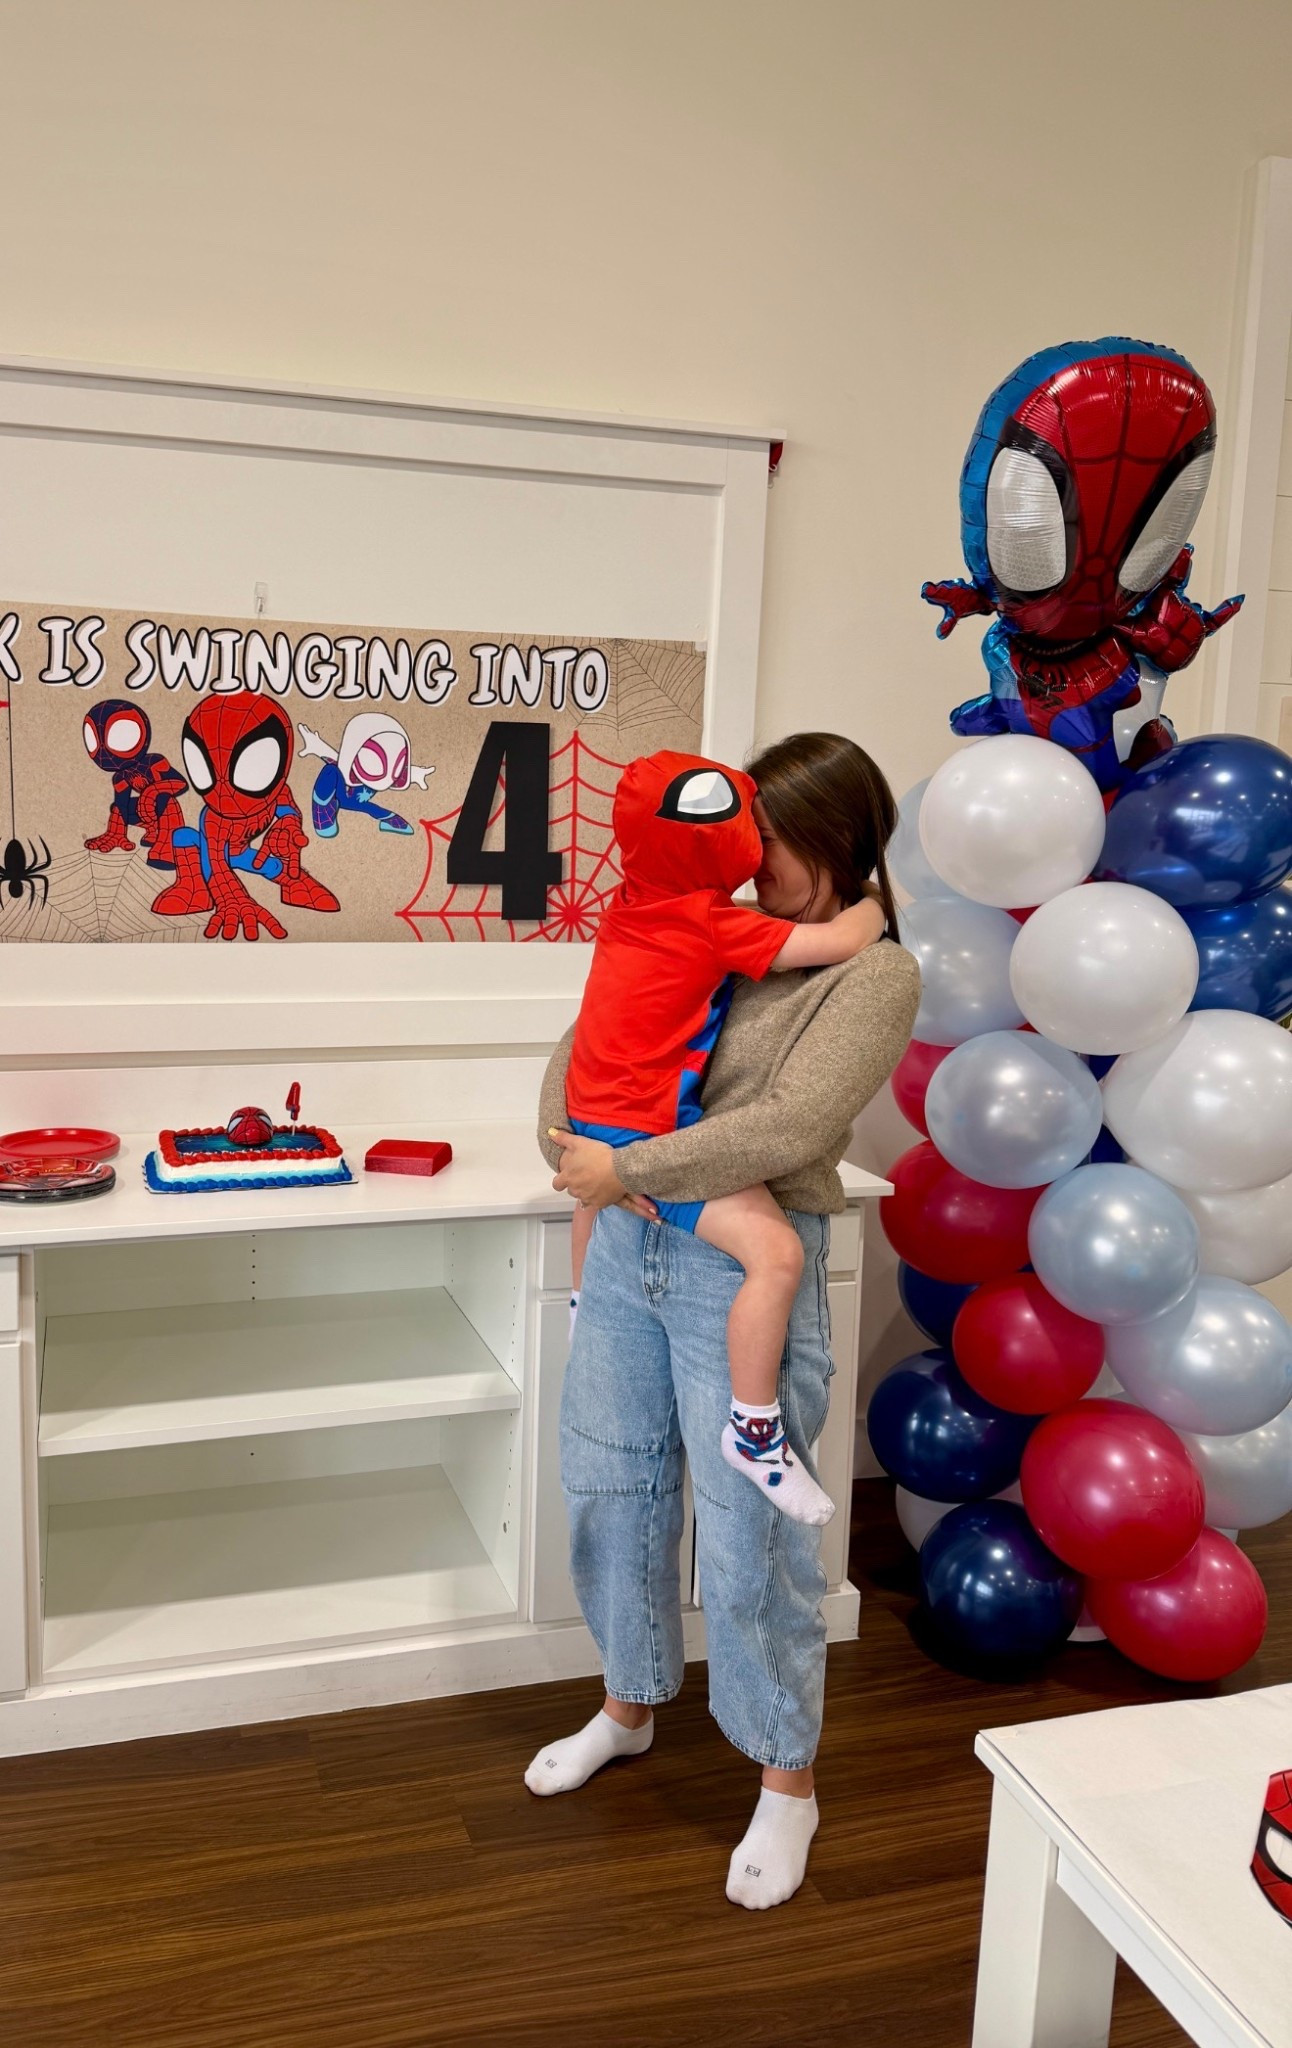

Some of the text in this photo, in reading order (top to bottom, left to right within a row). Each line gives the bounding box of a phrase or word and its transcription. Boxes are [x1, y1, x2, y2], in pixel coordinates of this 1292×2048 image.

[38, 615, 106, 689] IS
[125, 619, 457, 707] SWINGING
[468, 643, 610, 713] INTO
[447, 721, 562, 920] 4
